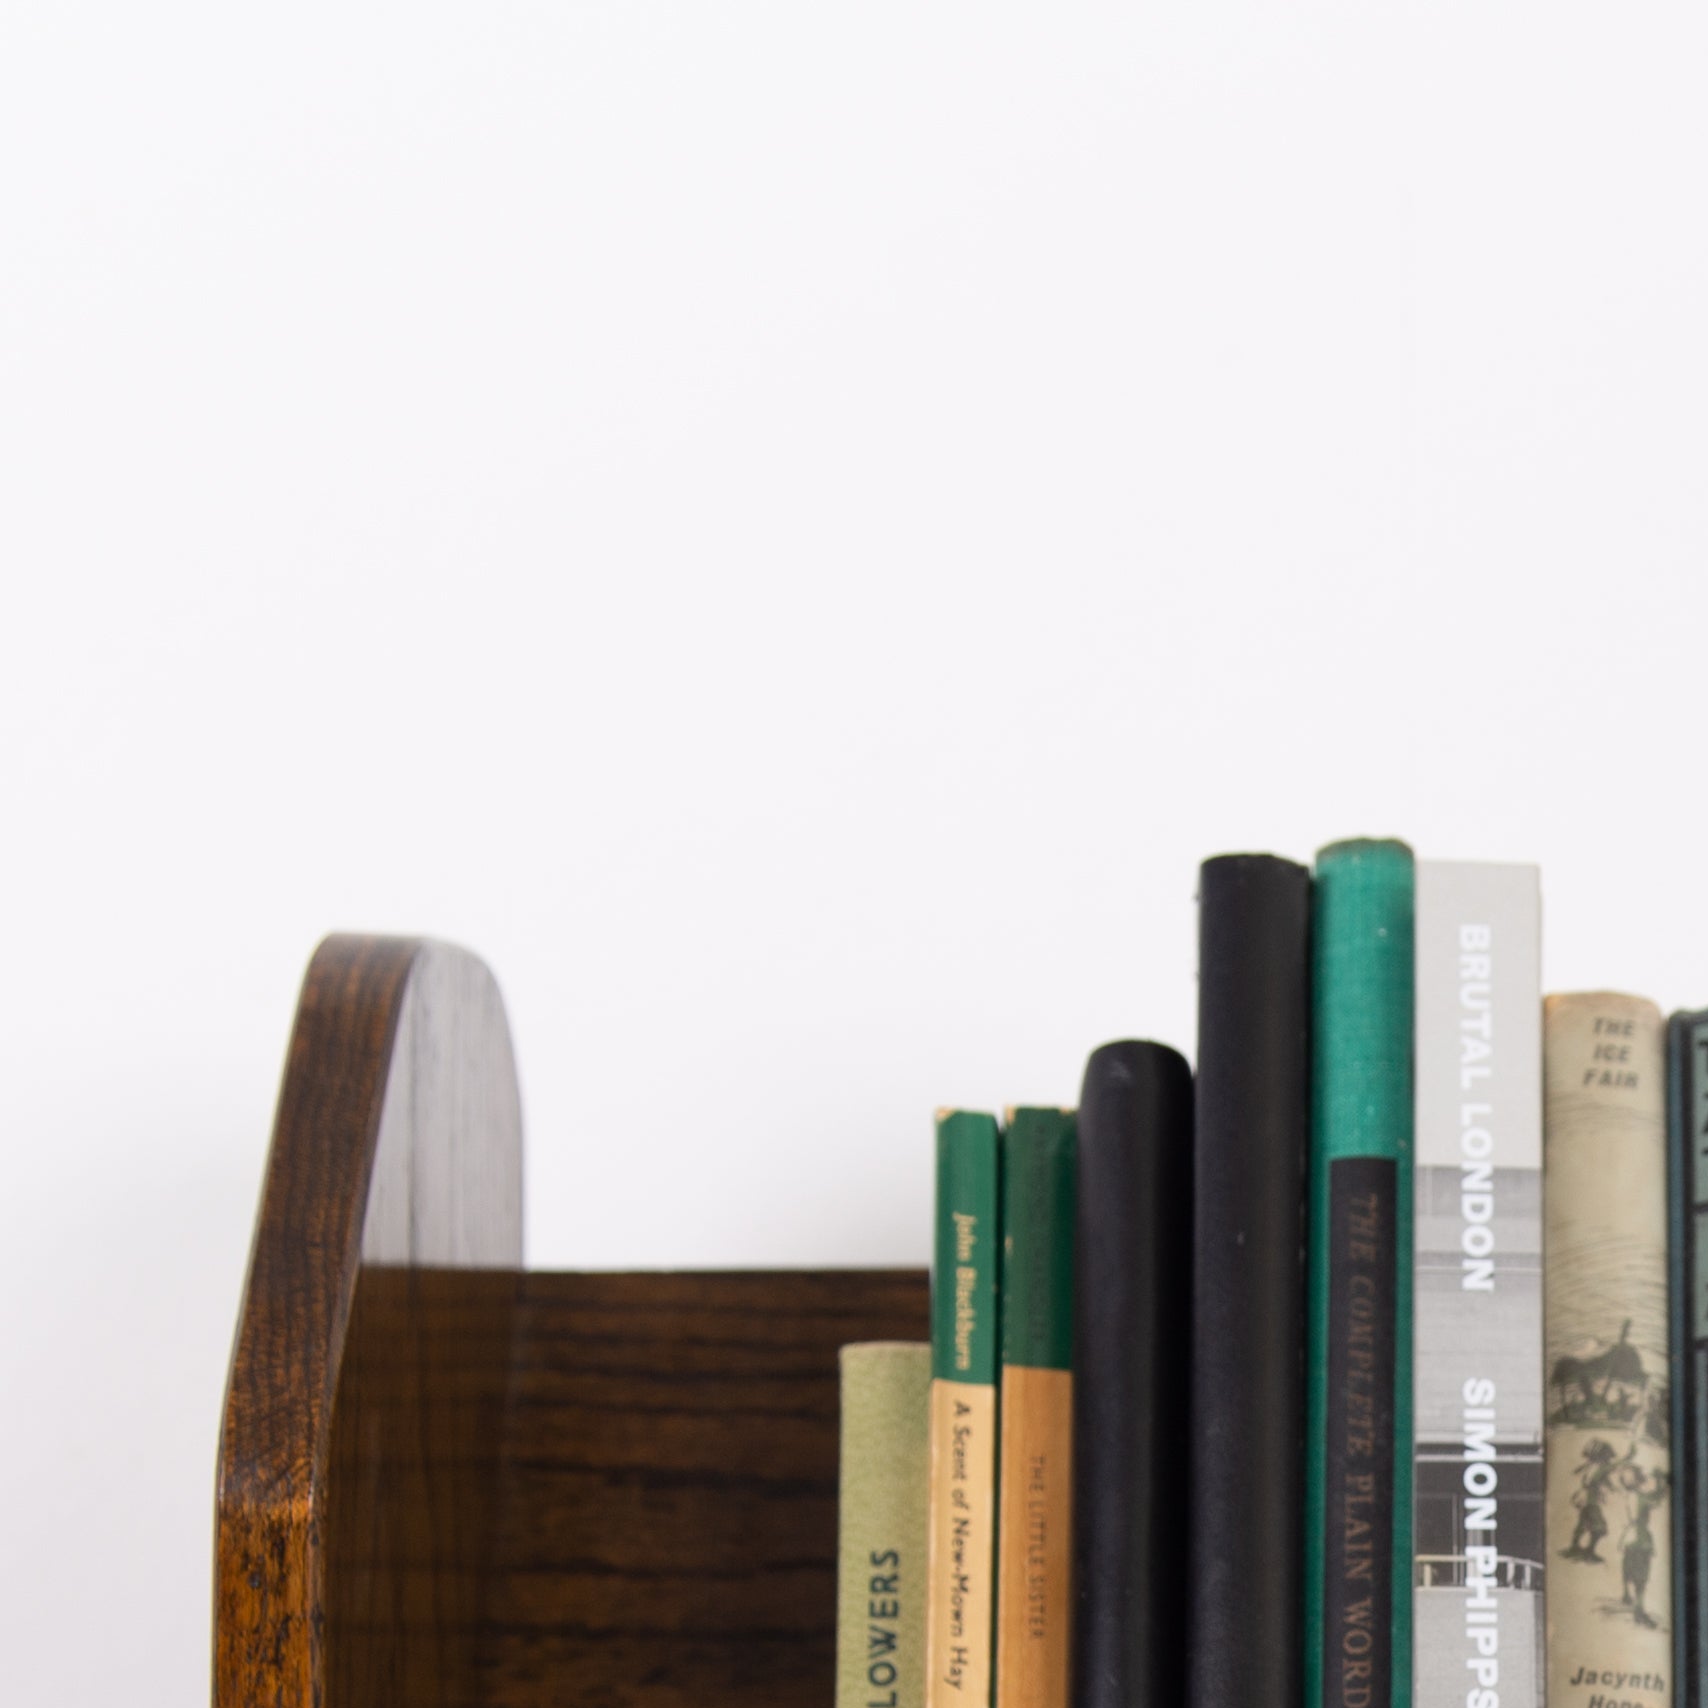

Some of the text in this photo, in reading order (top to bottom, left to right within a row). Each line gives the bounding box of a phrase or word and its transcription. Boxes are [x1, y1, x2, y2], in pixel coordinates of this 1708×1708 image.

[1591, 1043, 1632, 1065] ICE
[1592, 1016, 1636, 1038] THE
[1581, 1067, 1640, 1090] FAIR
[1459, 923, 1496, 1293] BRUTAL LONDON
[1348, 1191, 1378, 1264] THE
[952, 1210, 977, 1370] John Blackburn
[1346, 1274, 1377, 1457] COMPLETE
[953, 1399, 972, 1418] A
[951, 1424, 971, 1481] Scent
[1461, 1376, 1499, 1531] SIMON
[950, 1487, 970, 1511] of
[1344, 1473, 1376, 1581] PLAIN
[1026, 1455, 1047, 1640] THE LITTLE SISTER
[943, 1646, 969, 1691] Hay
[1569, 1666, 1666, 1692] Jacynth
